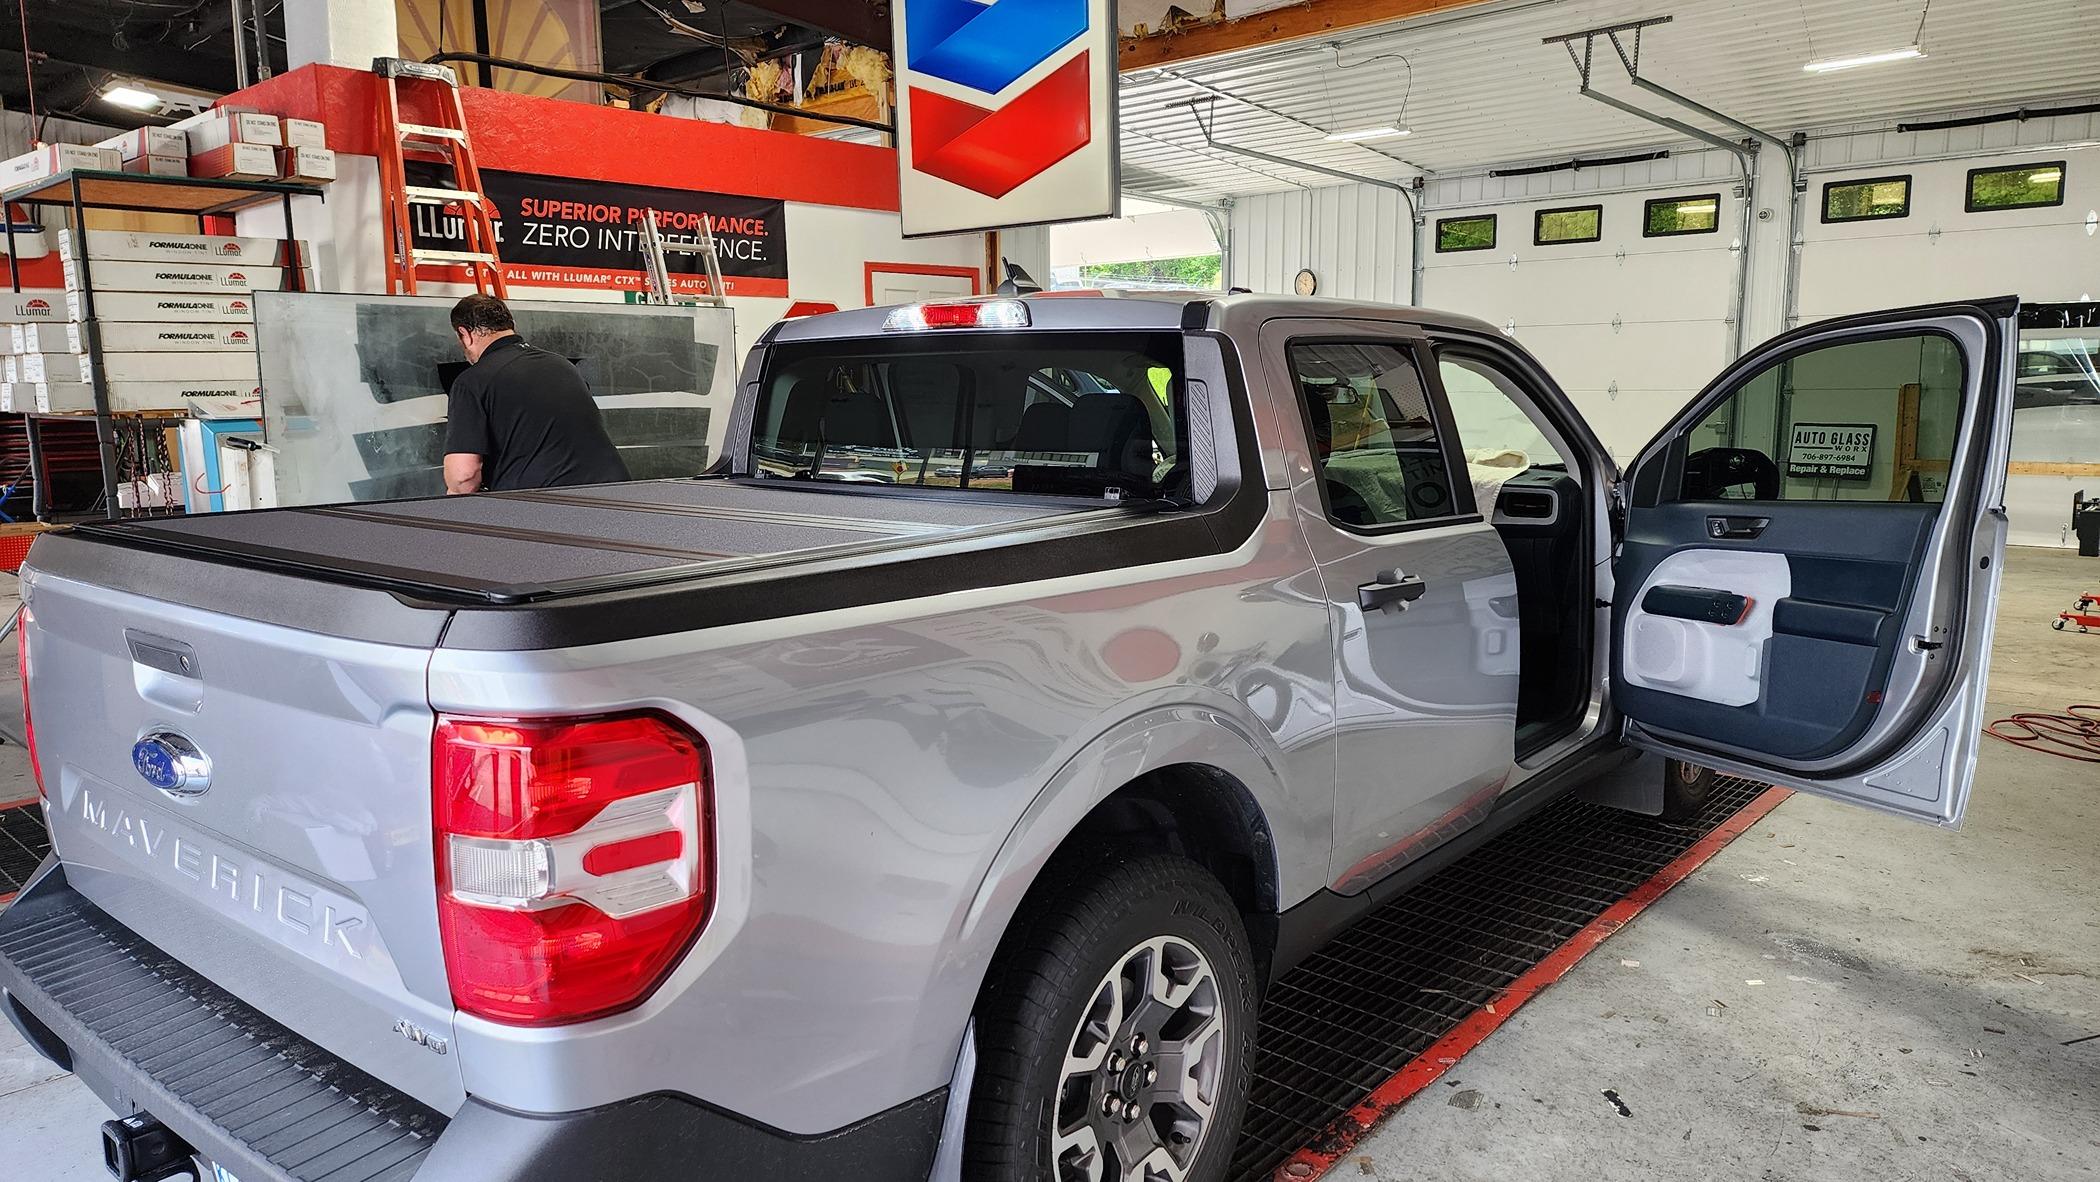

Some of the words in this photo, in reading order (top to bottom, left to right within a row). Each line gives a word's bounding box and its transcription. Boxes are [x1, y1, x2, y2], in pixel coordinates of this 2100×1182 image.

[520, 197, 621, 224] SUPERIOR
[627, 207, 769, 236] PRFORANCE.
[522, 222, 590, 248] ZERO
[466, 267, 489, 277] GT
[507, 270, 527, 279] ALL
[531, 271, 560, 281] WITH
[644, 277, 677, 288] SES
[680, 279, 707, 289] AUTO
[15, 304, 52, 317] LLumar
[1795, 431, 1826, 444] AUTO
[1830, 432, 1870, 446] GLASS
[1802, 453, 1856, 462] 706-897-6984
[1789, 464, 1819, 474] Repair
[1820, 465, 1828, 473] &
[1829, 466, 1866, 476] Replace
[138, 747, 166, 782] Ford
[83, 789, 363, 959] MAVERICK
